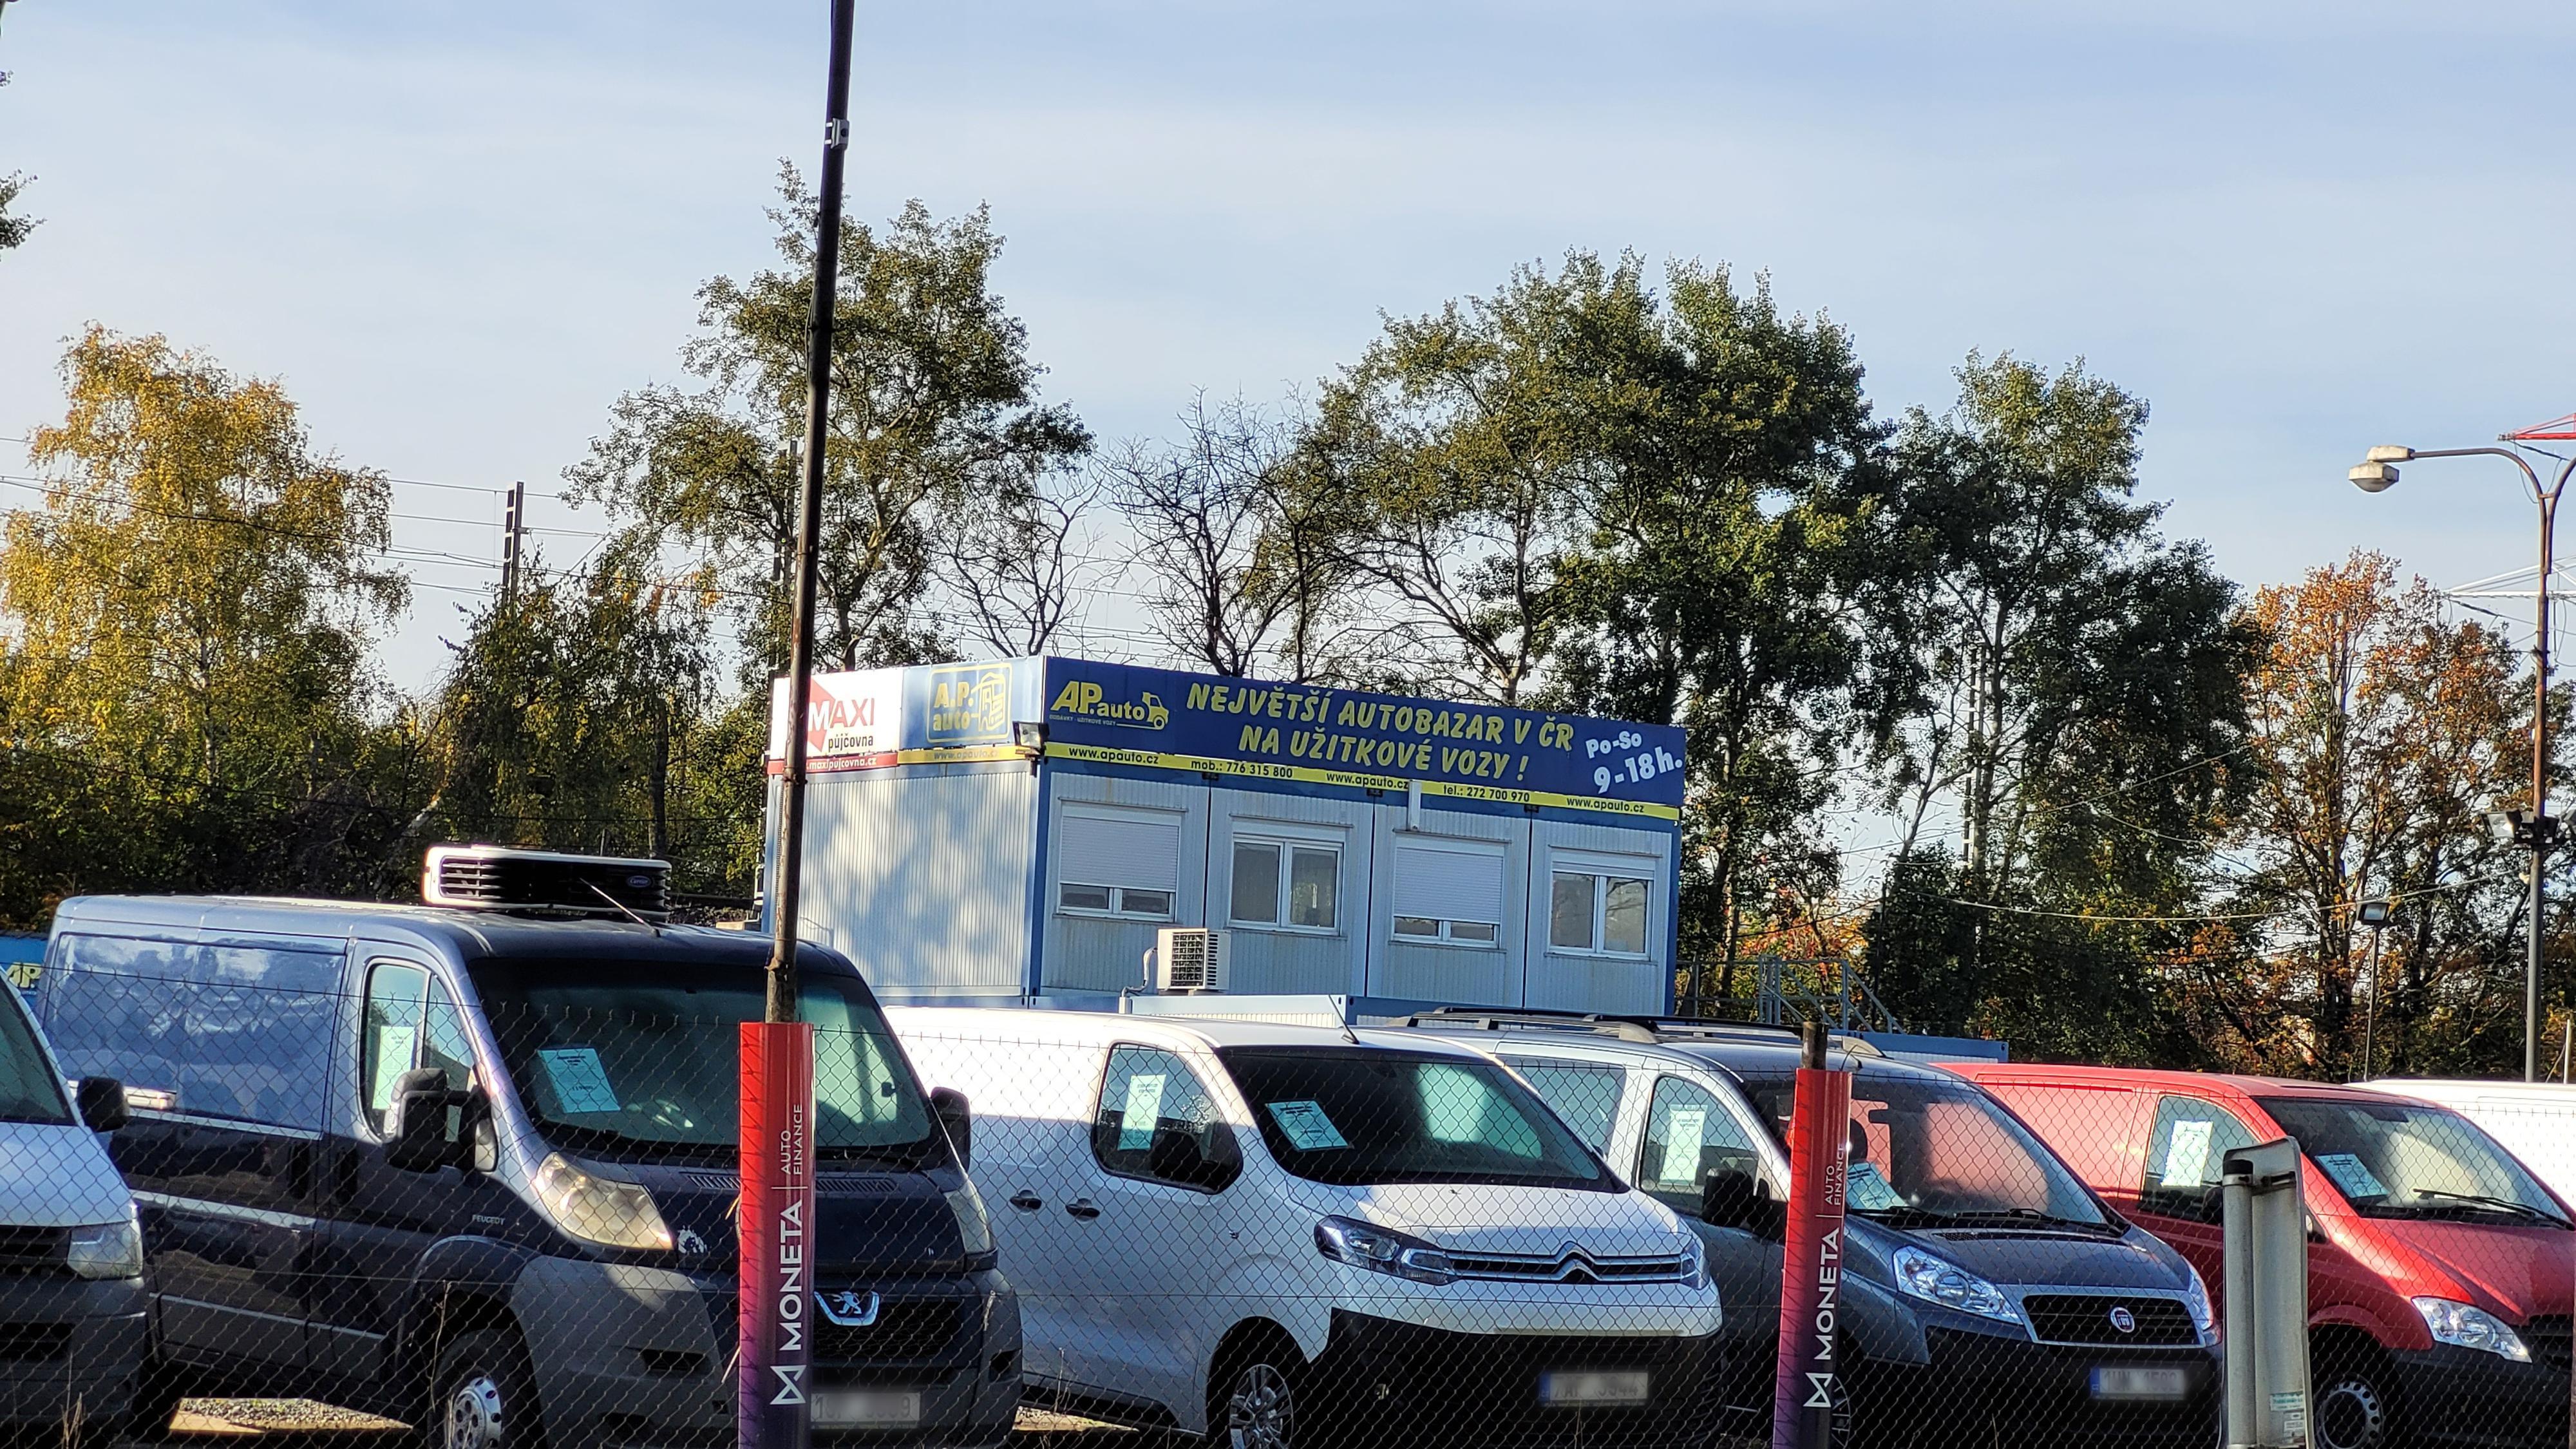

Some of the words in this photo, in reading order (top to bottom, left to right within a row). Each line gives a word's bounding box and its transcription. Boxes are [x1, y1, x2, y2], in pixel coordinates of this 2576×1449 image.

[934, 682, 974, 708] A.P.
[809, 697, 875, 732] MAXI
[933, 711, 970, 731] auto
[1186, 683, 1334, 723] NEJVĚTŠÍ
[1338, 700, 1504, 744] AUTOBAZAR
[1514, 718, 1532, 744] V
[1539, 715, 1574, 752] ČR
[828, 733, 873, 752] půjčovna
[1238, 724, 1279, 755] NA
[1290, 726, 1432, 771] UŽITKOVÉ
[1442, 746, 1510, 779] VOZY
[806, 757, 876, 771] .maxipujcovna.cz
[1069, 748, 1159, 764] www.apauto.cz
[1191, 759, 1222, 772] mob.:
[1226, 762, 1245, 773] 776
[1249, 764, 1269, 775] 315
[1273, 766, 1293, 778] 800
[1327, 773, 1408, 790] www.apauto.cz
[1443, 784, 1463, 795] tel.:
[1466, 788, 1485, 799] 272
[1489, 790, 1508, 800] 700
[1511, 791, 1530, 802] 970
[1567, 798, 1644, 813] www.apauto.cz
[781, 1130, 791, 1175] AUTO
[793, 1104, 802, 1175] FINANCE
[1824, 1165, 1835, 1206] AUTO
[779, 1199, 802, 1351] MONETA
[1814, 1227, 1839, 1360] MONETA
